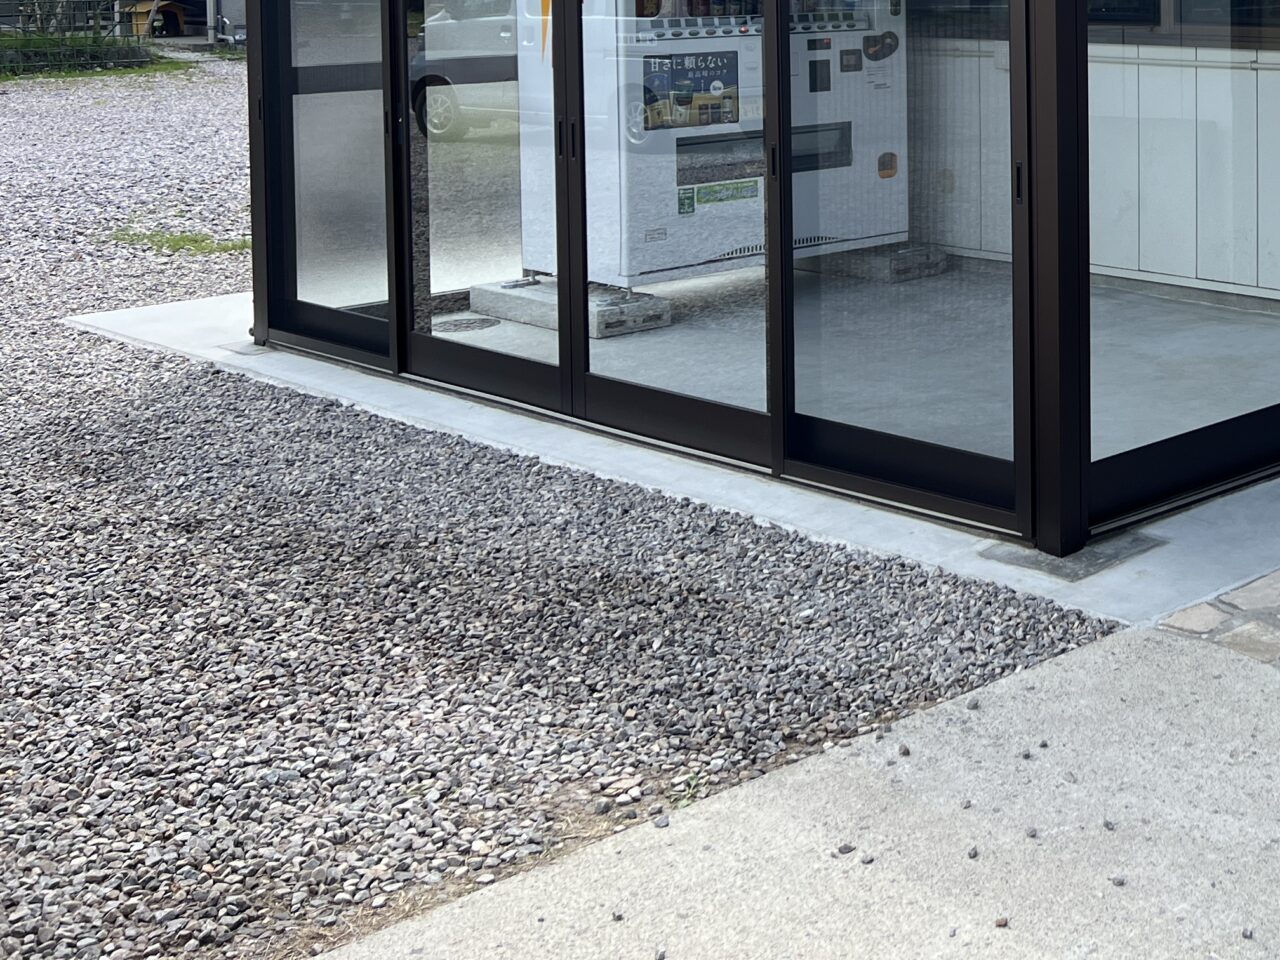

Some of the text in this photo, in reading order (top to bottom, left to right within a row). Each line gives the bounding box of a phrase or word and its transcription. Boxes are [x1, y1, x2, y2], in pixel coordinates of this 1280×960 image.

[650, 55, 728, 72] 甘さに頼らない
